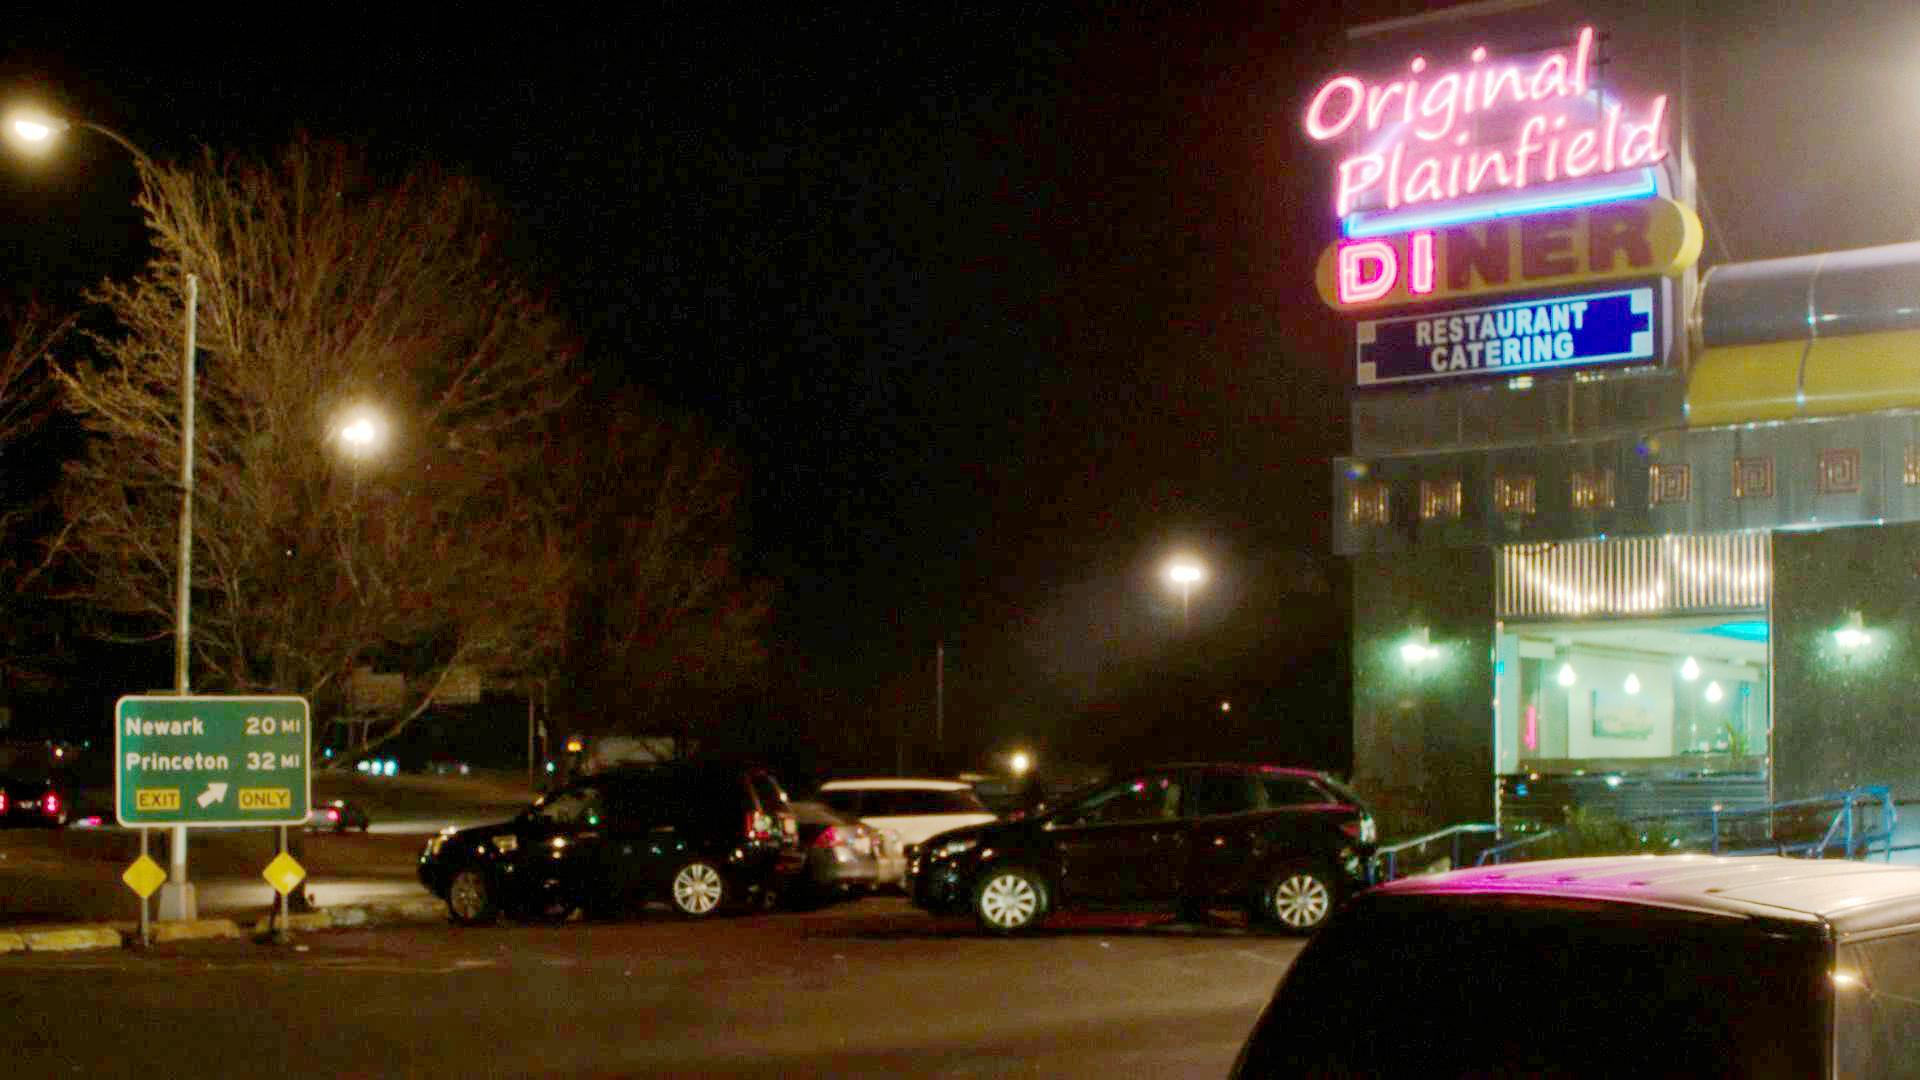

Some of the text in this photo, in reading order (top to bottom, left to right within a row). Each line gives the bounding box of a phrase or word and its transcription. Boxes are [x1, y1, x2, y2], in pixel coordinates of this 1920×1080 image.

[1305, 26, 1594, 141] Original
[1336, 94, 1668, 217] Plainfield
[1338, 218, 1655, 304] DINER
[1415, 301, 1589, 347] RESTAURANT
[1430, 332, 1575, 372] CATERING
[125, 716, 301, 736] Newark 20 MI
[125, 751, 300, 770] Princeton 32 MI
[138, 791, 288, 807] EXIT ONLY
